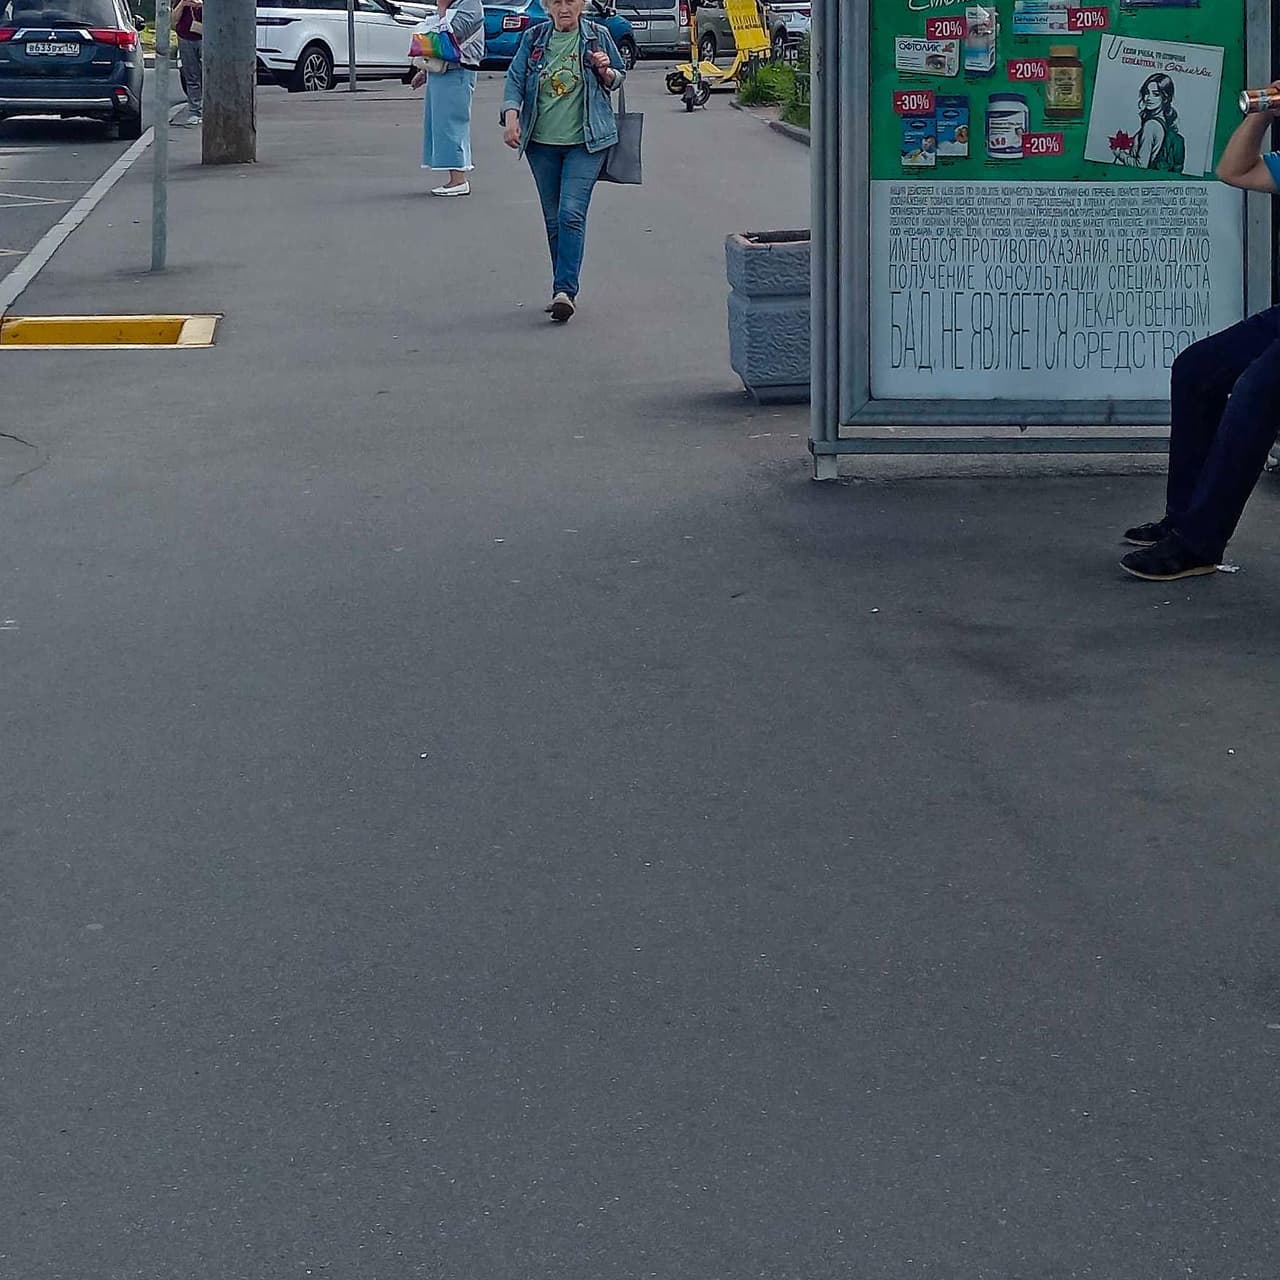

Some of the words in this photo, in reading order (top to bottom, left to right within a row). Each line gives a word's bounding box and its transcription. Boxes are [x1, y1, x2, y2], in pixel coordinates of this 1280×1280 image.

[1071, 11, 1105, 27] -20%
[929, 20, 963, 37] -20%
[1010, 62, 1044, 78] -20%
[896, 94, 930, 110] -30%
[1025, 137, 1059, 153] -20%
[889, 238, 957, 263] ИМЕЮТСЯ
[1117, 238, 1210, 264] НЕОБХОДИМО
[889, 264, 975, 289] ПОЛУЧЕНИЕ
[985, 265, 1099, 291] КОНСУЛЬТАЦИИ
[1108, 265, 1210, 291] СПЕЦИАЛИСТА
[942, 291, 965, 370] НЕ
[971, 292, 1068, 370] ЯВЛЯЕТСЯ
[1074, 291, 1210, 328] ЛЕКАРСТВЕННЫМ
[1073, 330, 1210, 374] СРЕДСТВО
